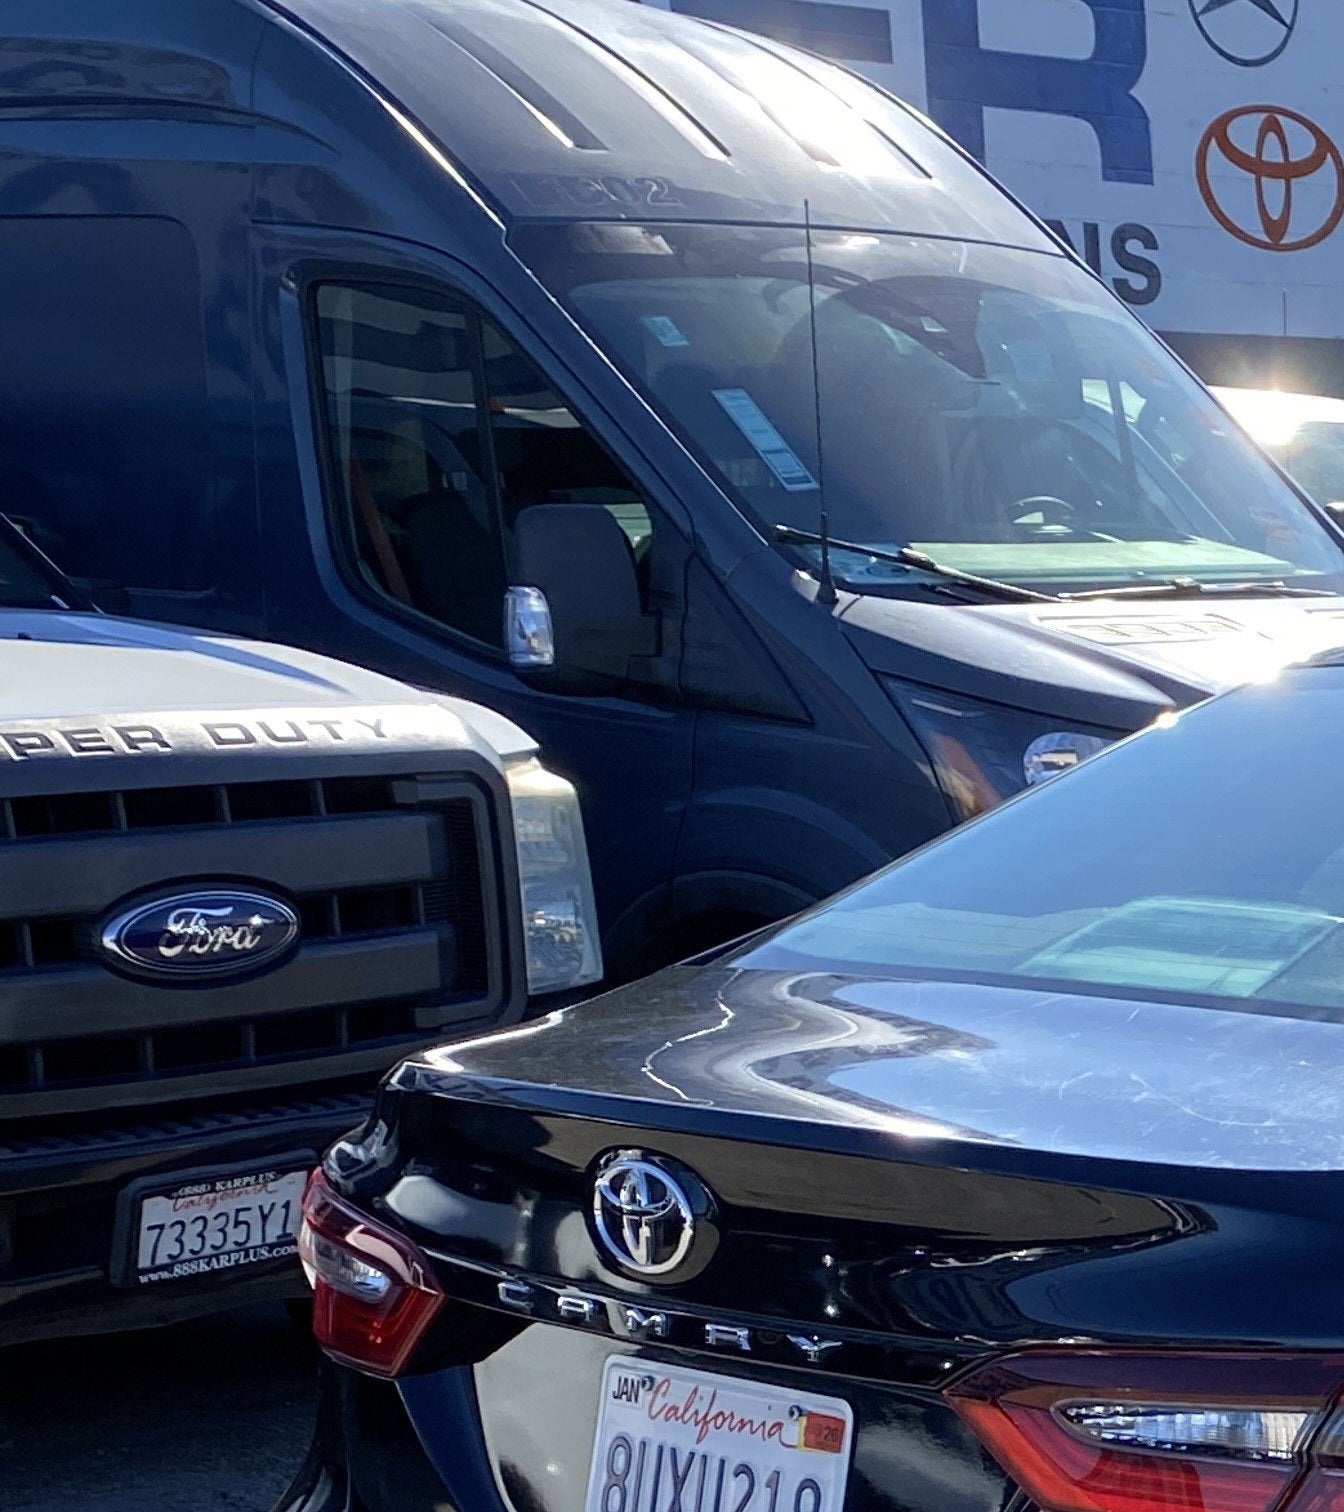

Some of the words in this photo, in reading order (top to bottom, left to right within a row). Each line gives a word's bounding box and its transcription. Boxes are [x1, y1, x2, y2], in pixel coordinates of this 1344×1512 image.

[200, 718, 388, 751] DUTY
[158, 906, 268, 957] Ford
[214, 1172, 278, 1191] KARPLUS
[146, 1199, 294, 1266] 73335Y1
[498, 1280, 843, 1363] CAMRY
[612, 1375, 641, 1404] JAN
[647, 1377, 798, 1449] California
